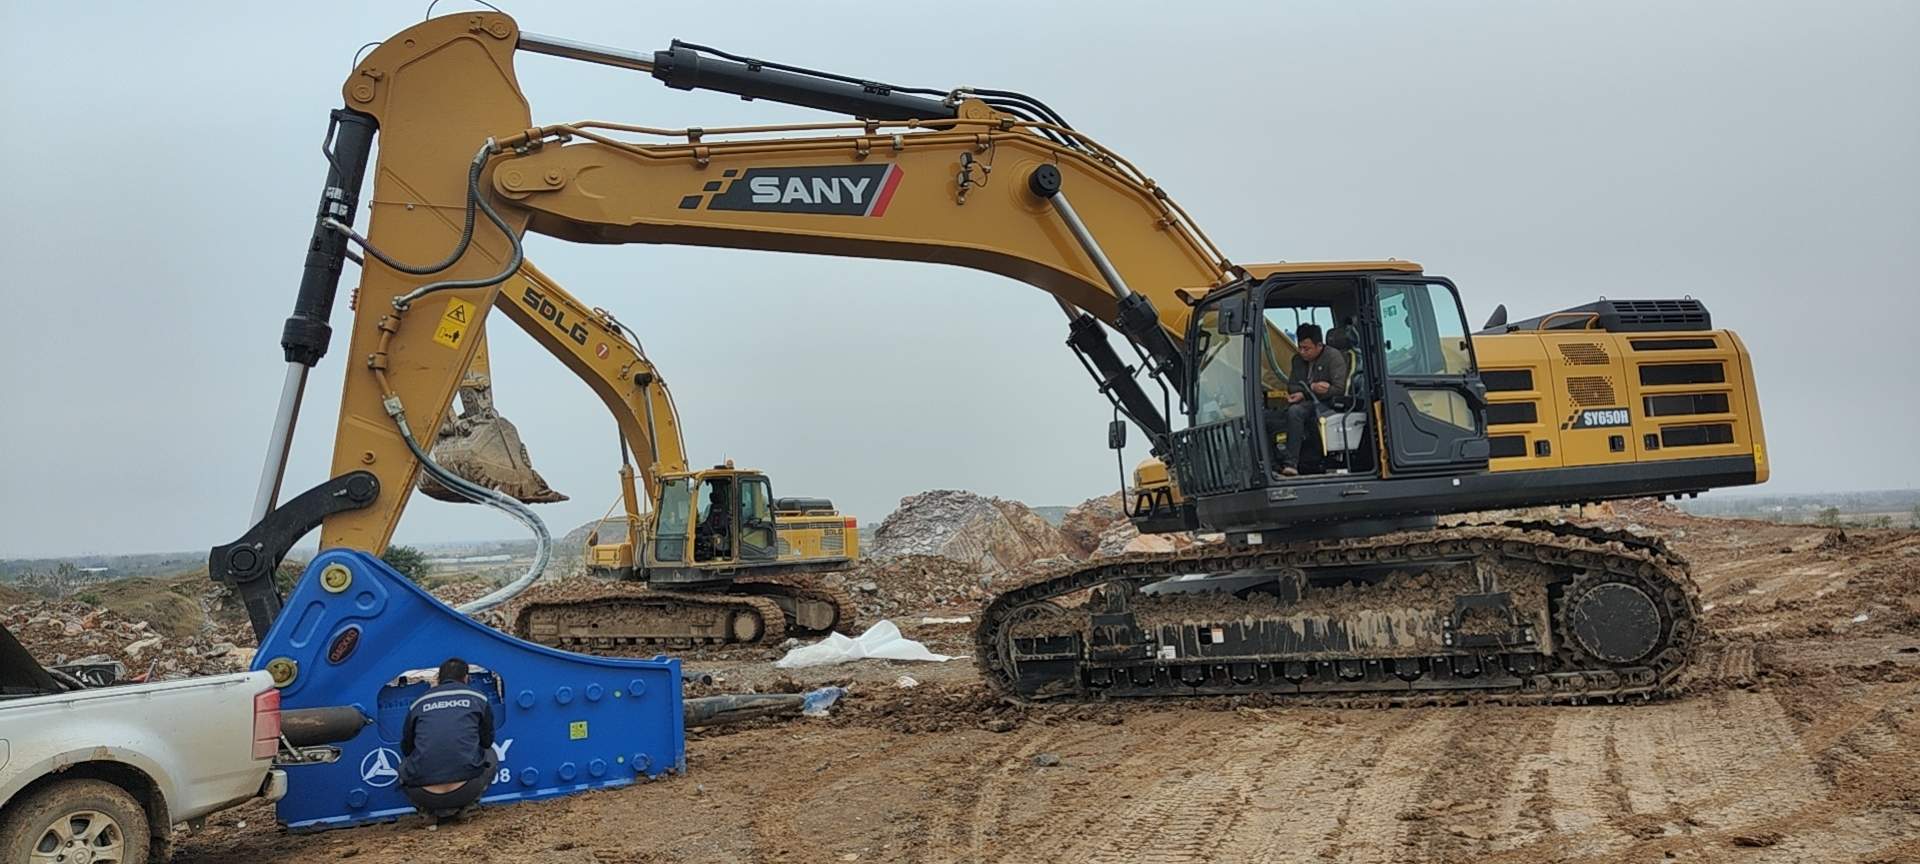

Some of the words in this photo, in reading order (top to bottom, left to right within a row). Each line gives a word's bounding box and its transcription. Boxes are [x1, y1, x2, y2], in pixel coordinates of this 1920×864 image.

[750, 177, 871, 204] SANY
[522, 286, 589, 346] SDLG
[1583, 409, 1629, 426] SY650H
[422, 699, 471, 712] DAEKKO
